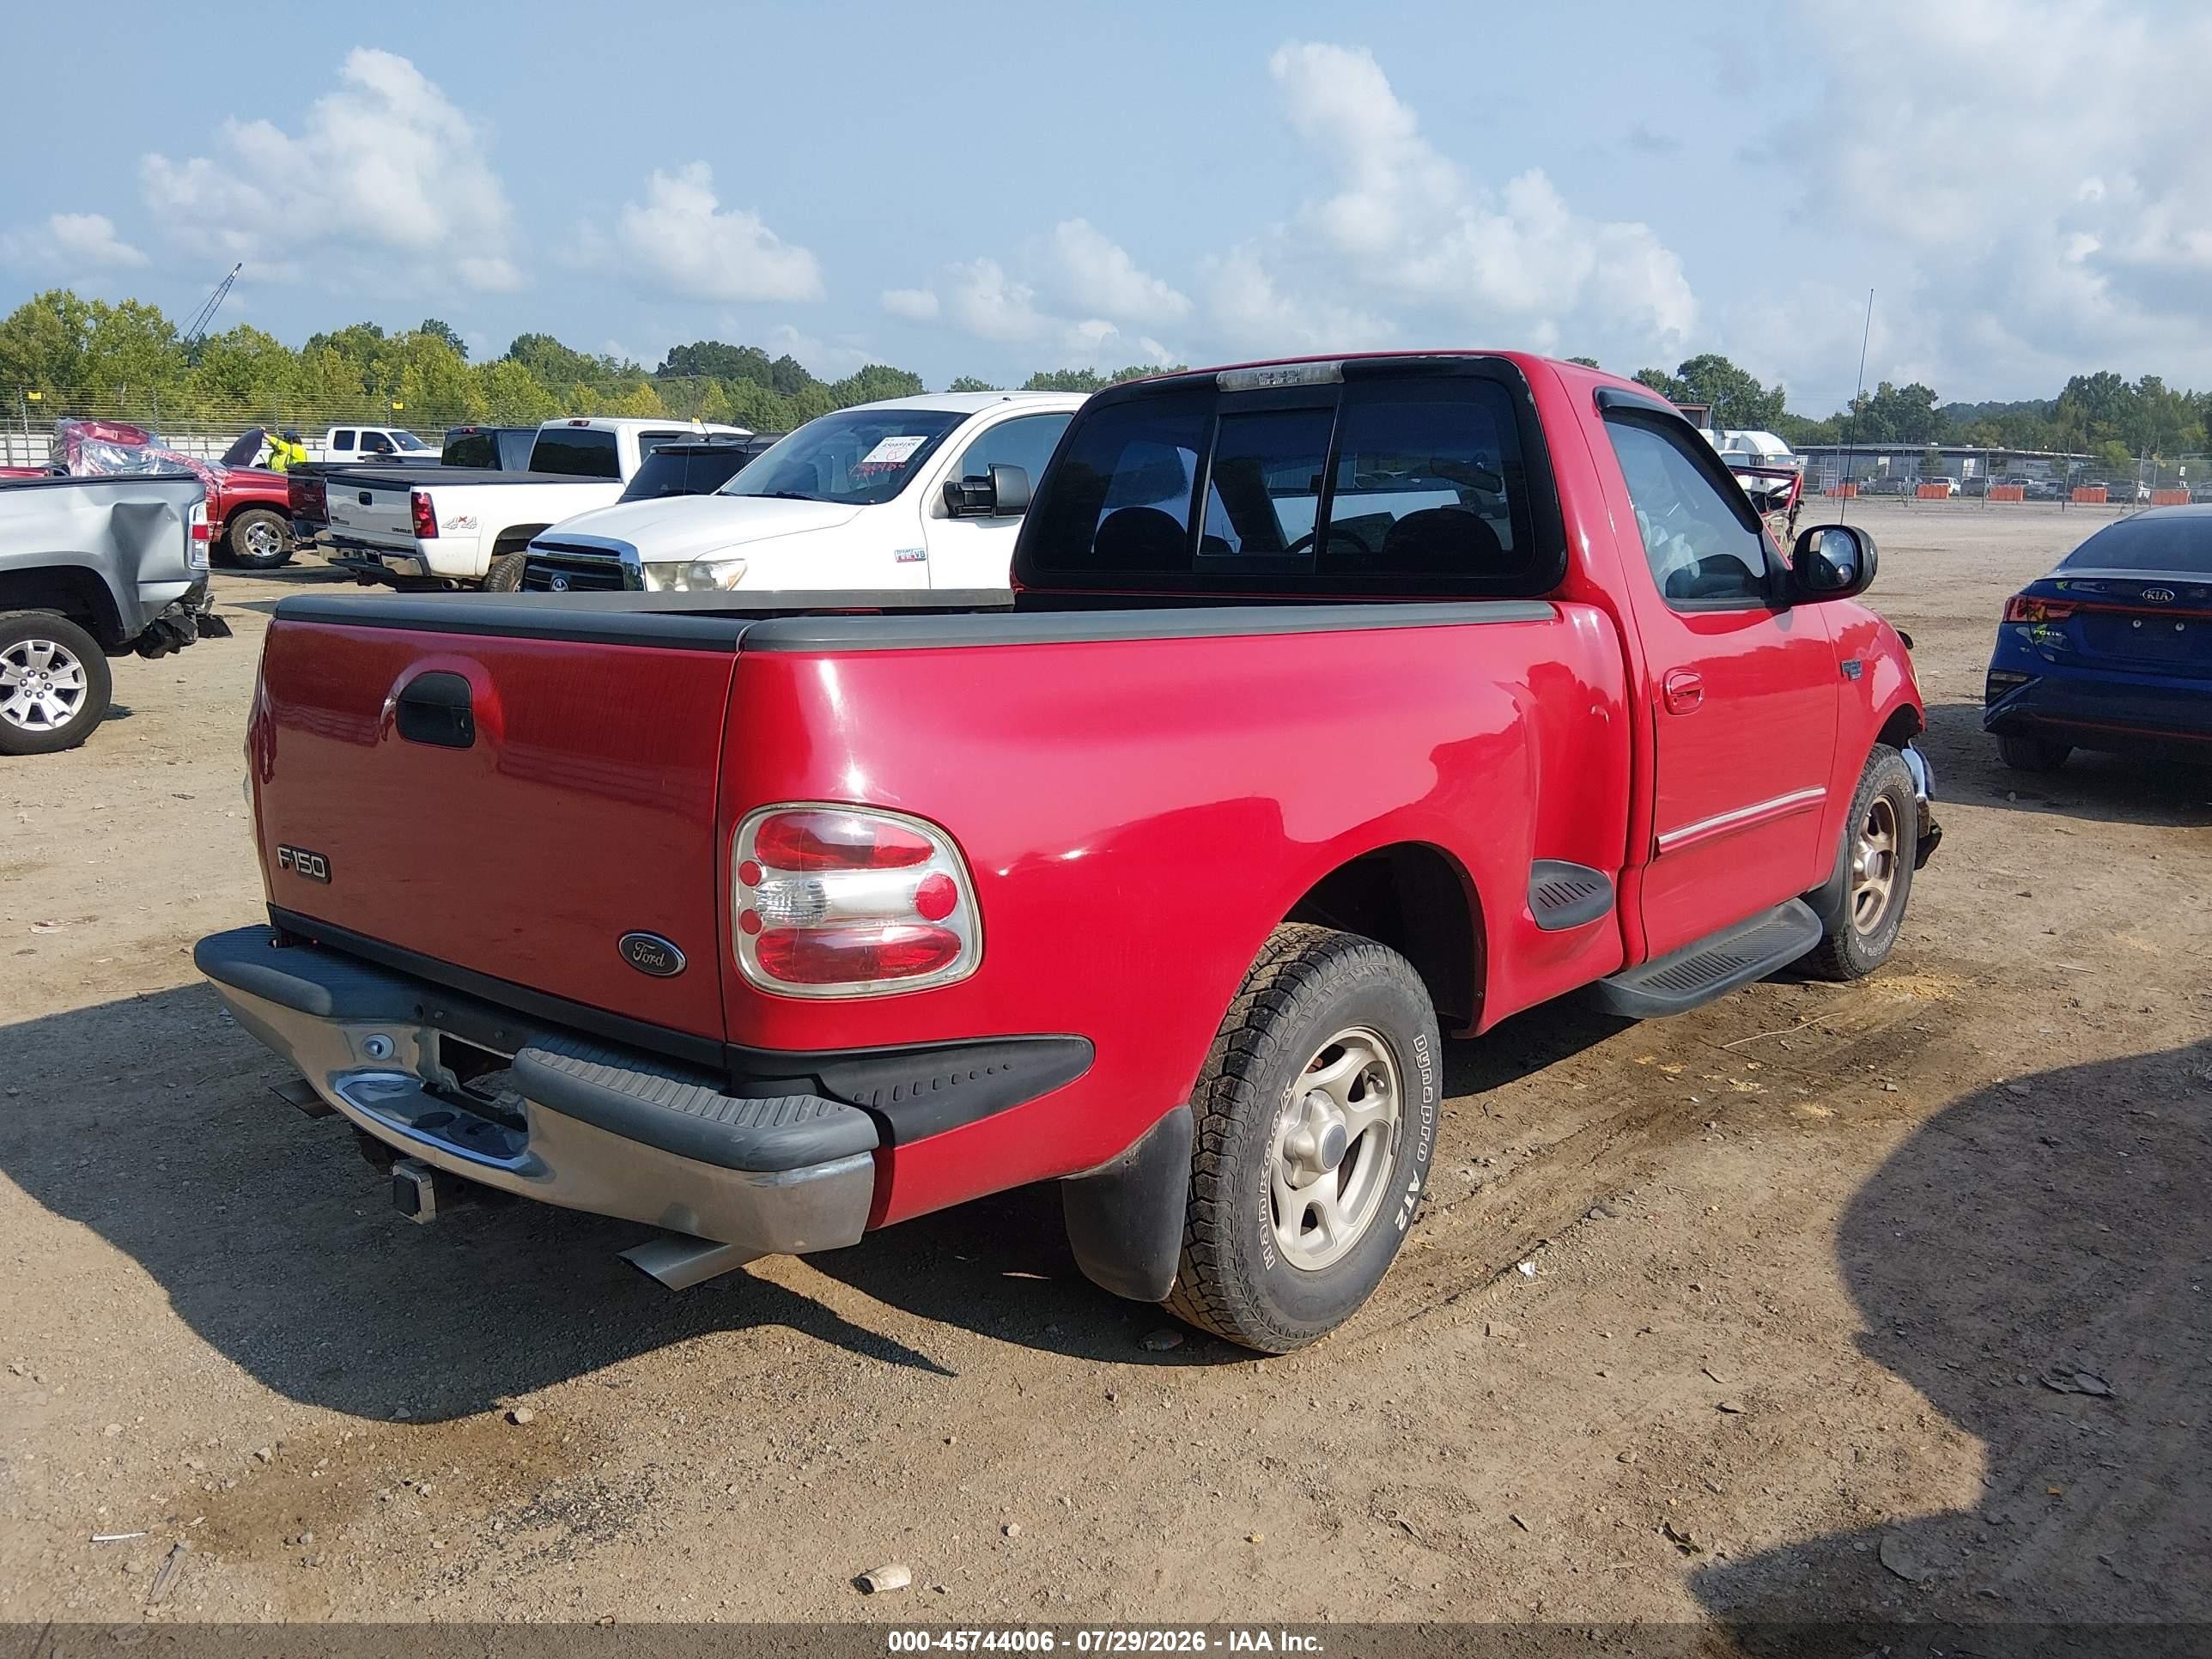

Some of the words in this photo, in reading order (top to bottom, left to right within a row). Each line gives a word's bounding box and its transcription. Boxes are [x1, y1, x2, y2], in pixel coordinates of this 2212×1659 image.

[2147, 590, 2169, 600] KIA
[276, 847, 326, 878] F-150
[632, 941, 666, 968] Ford
[1395, 1168, 1421, 1231] AT2
